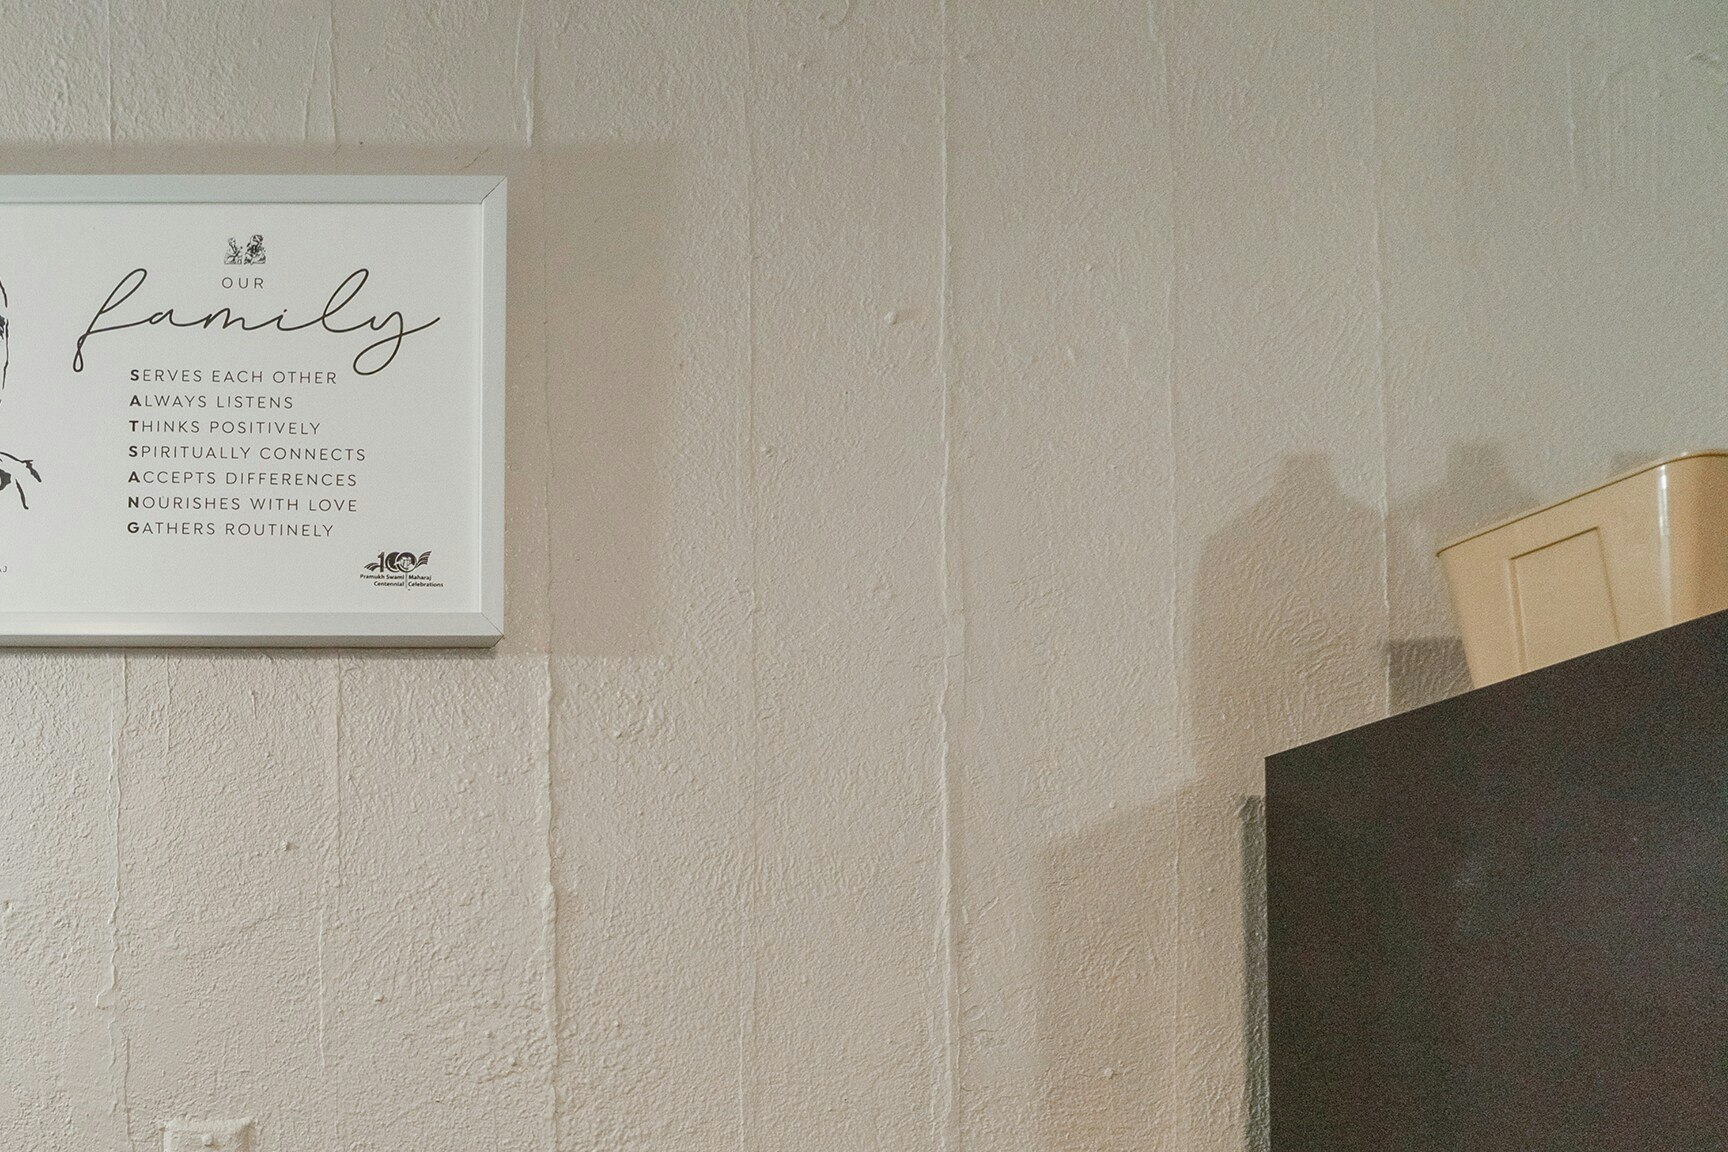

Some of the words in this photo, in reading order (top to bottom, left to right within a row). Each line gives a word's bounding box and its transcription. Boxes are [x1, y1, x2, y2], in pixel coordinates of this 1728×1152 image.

[221, 276, 265, 289] OUR
[72, 267, 441, 375] family
[130, 369, 203, 382] SERVES
[211, 370, 264, 383] EACH
[272, 371, 338, 384] OTHER
[129, 394, 207, 408] ALWAYS
[216, 395, 294, 409] LISTENS
[128, 420, 200, 433] THINKS
[209, 420, 321, 435] POSITIVELY
[128, 445, 251, 459] SPIRITUALLY
[259, 447, 366, 461] CONNECTS
[128, 471, 216, 484] ACCEPTS
[225, 472, 357, 486] DIFFERENCES
[128, 496, 241, 510] NOURISHES
[249, 497, 299, 511] WITH
[308, 499, 358, 512] LOVE
[127, 521, 216, 535] GATHERS
[225, 523, 334, 537] ROUTINELY
